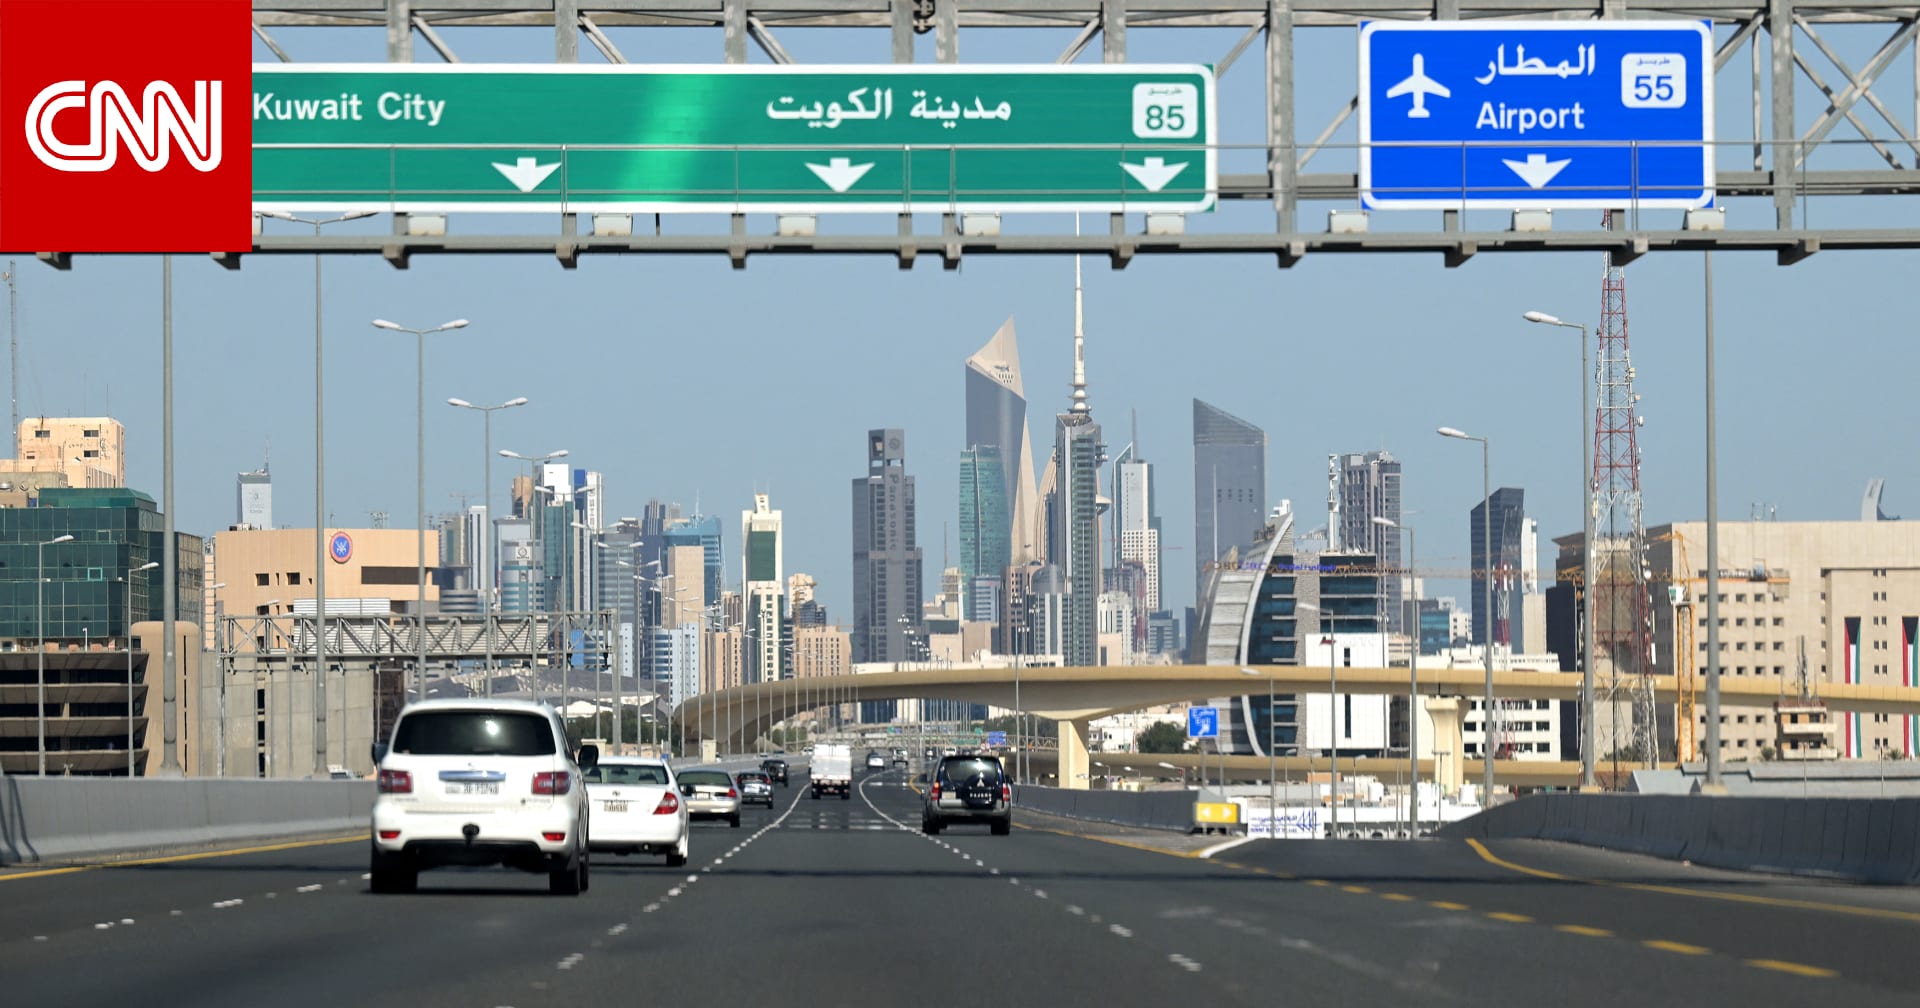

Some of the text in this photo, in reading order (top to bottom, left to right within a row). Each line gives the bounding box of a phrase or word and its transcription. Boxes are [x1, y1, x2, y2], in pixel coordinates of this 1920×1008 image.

[1475, 44, 1596, 85] المطار
[1634, 75, 1674, 101] 55
[253, 91, 445, 126] Kuwait City
[766, 87, 1012, 129] مدينة الكويت
[1145, 105, 1185, 131] 85
[1476, 102, 1585, 134] Airport
